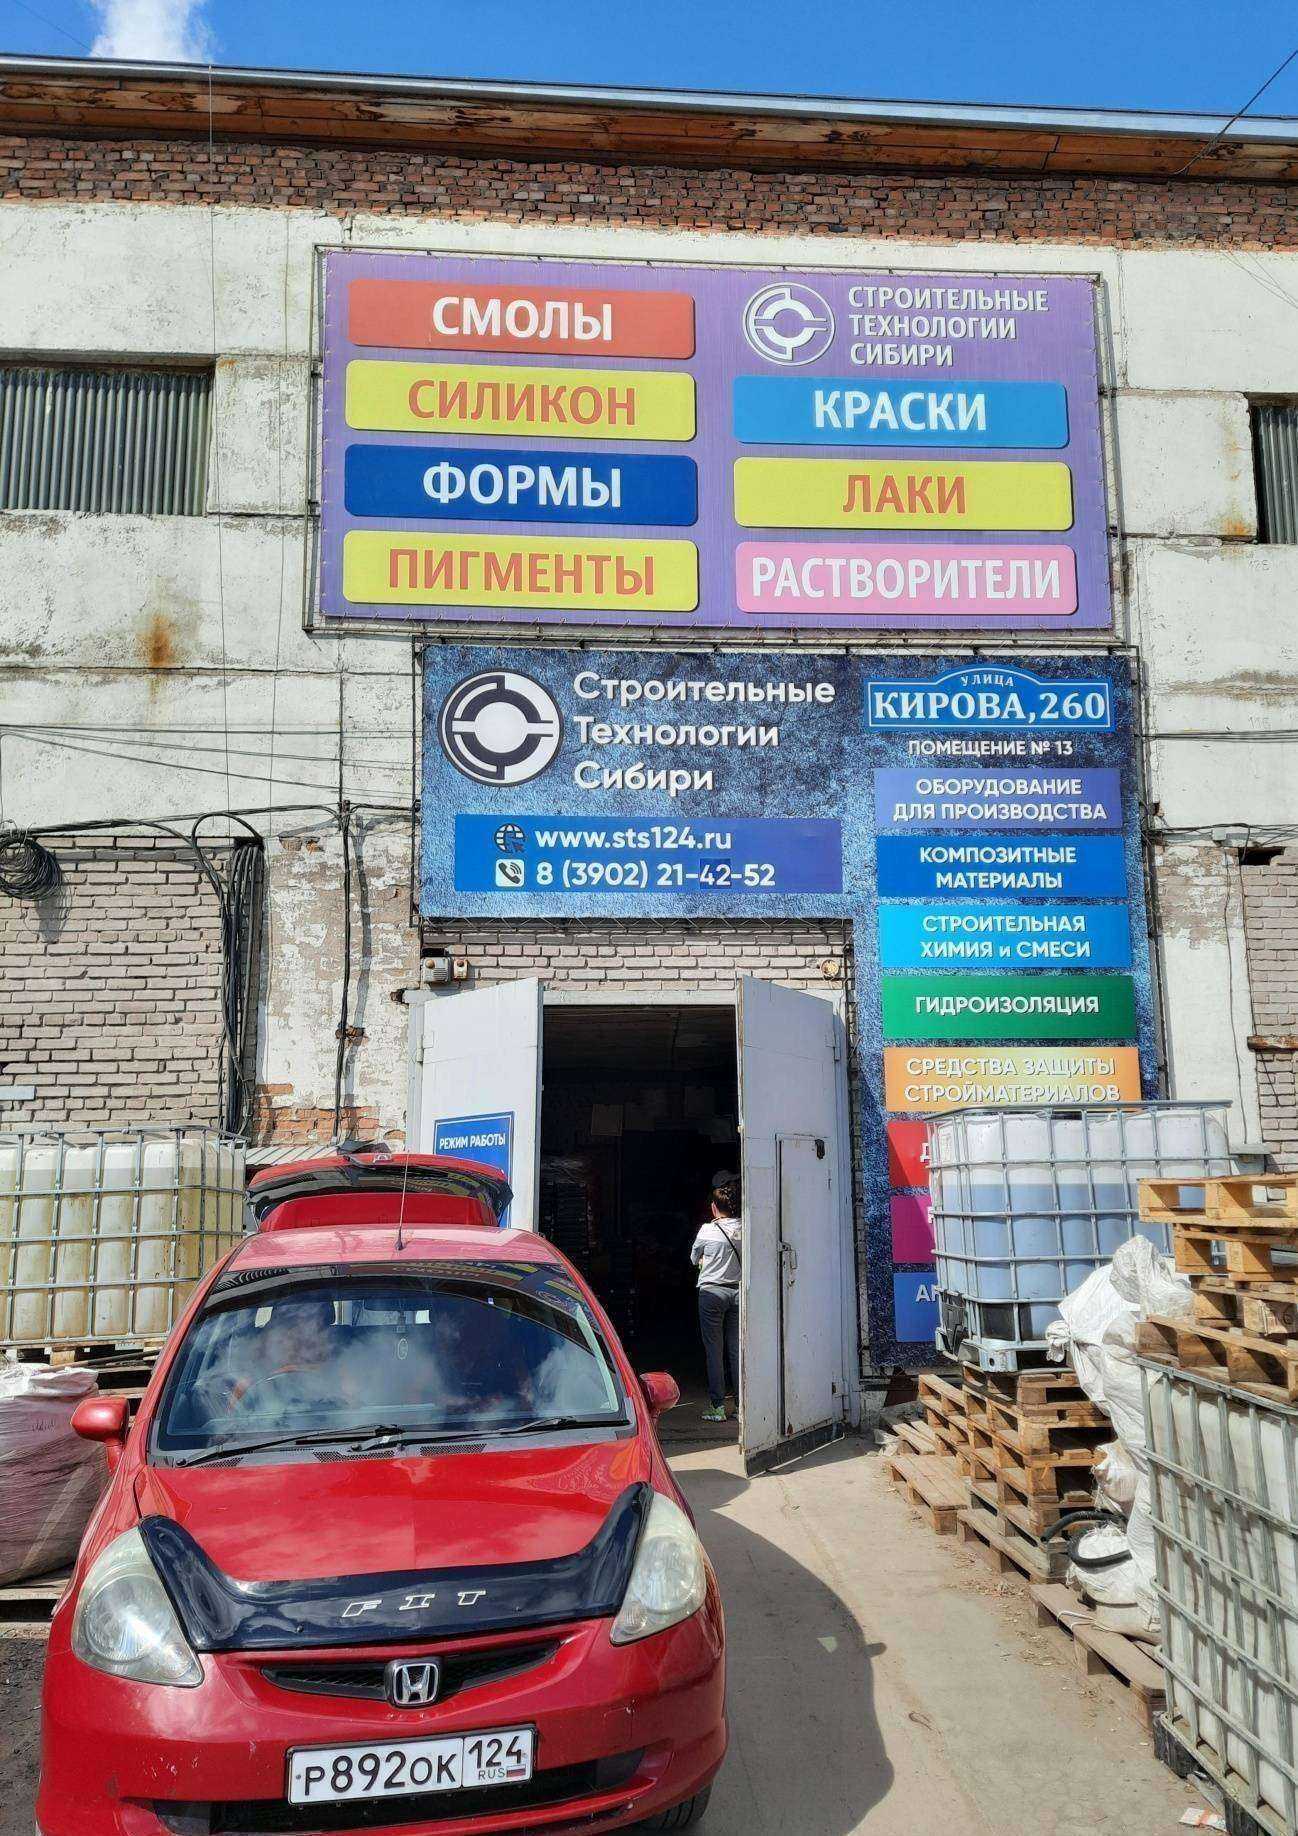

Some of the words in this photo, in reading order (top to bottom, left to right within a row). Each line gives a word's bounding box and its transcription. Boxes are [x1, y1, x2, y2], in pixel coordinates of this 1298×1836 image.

[848, 285, 1049, 312] СТРОИТЕЛЬНЫЕ
[432, 296, 613, 341] СМОЛЫ
[848, 313, 1018, 340] ТЕХНОЛОГИИ
[849, 341, 954, 367] СИБИРИ
[407, 379, 636, 426] СИЛИКОН
[813, 389, 986, 431] КРАСКИ
[422, 461, 621, 508] ФОРМЫ
[842, 474, 966, 515] ЛАКИ
[389, 548, 654, 596] ПИГМЕНТЫ
[751, 556, 1061, 600] РАСТВОРИТЕЛИ
[573, 671, 836, 707] Строительные
[960, 673, 1014, 688] УЛИЦА
[873, 690, 1106, 725] КИРОВА,260
[573, 715, 780, 747] Технологии
[907, 740, 1026, 758] ПОМЕЩЕНИЕ
[1054, 740, 1073, 755] 13
[573, 759, 715, 796] Сибири
[915, 778, 1082, 798] ОБОРУДОВАНИЕ
[893, 803, 935, 822] ДЛЯ
[941, 803, 1108, 822] ПРОИЗВОДСТВА
[535, 826, 732, 850] www.sts124.ru
[919, 846, 1077, 864] КОМПОЗИТНЫЕ
[535, 863, 554, 886] 8
[562, 859, 649, 889] (3902)
[657, 862, 776, 887] 21-42-52
[935, 872, 1063, 889] МАТЕРИАЛЫ
[922, 915, 1086, 933] СТРОИТЕЛЬНАЯ
[920, 941, 993, 958] ХИМИЯ
[1016, 941, 1091, 958] СМЕСИ
[915, 996, 1100, 1017] ГИДРОИЗОЛЯЦИЯ
[906, 1057, 1018, 1077] СРЕДСТВА
[1022, 1057, 1116, 1078] ЗАЩИТЫ
[904, 1080, 1121, 1103] СТРОЙМАТЕРИАЛОВ
[439, 1136, 468, 1149] РЕЖИМ
[470, 1133, 505, 1147] РАБОТЫ
[467, 1735, 523, 1768] 124
[477, 1767, 506, 1781] RUS
